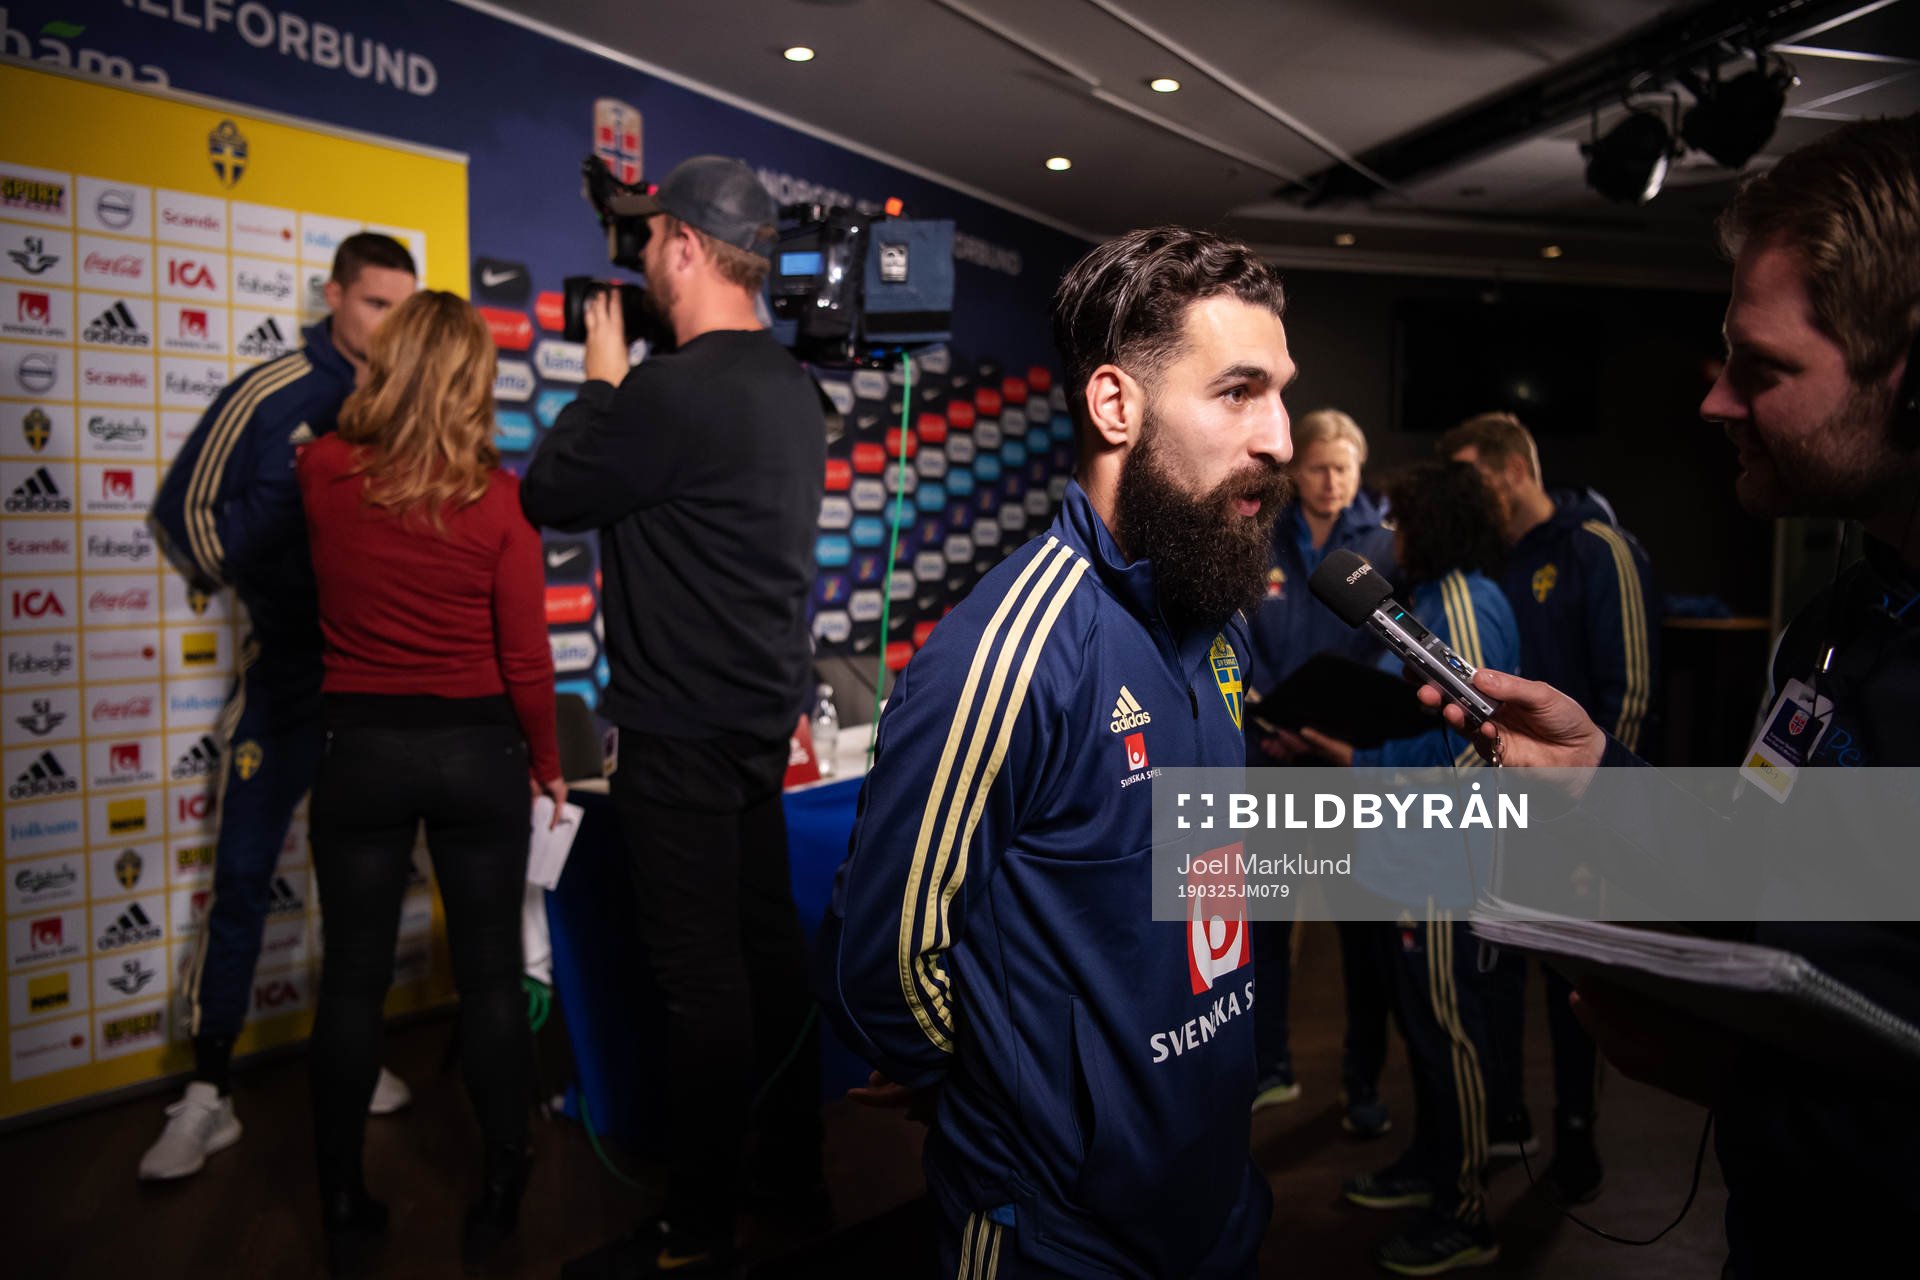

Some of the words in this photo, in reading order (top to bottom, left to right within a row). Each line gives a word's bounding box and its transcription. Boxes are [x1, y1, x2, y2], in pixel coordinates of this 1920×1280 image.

[122, 0, 438, 95] LLFORBUND
[162, 208, 220, 232] Scandic
[168, 260, 216, 290] ICA
[83, 327, 149, 346] adidas
[86, 368, 147, 388] Scandic
[4, 497, 72, 513] adidas
[6, 538, 69, 555] Scandic
[13, 590, 65, 619] ICA
[1110, 711, 1151, 734] adidas
[1146, 768, 1163, 780] SPEL
[9, 777, 78, 799] adidas
[98, 927, 163, 950] adidas
